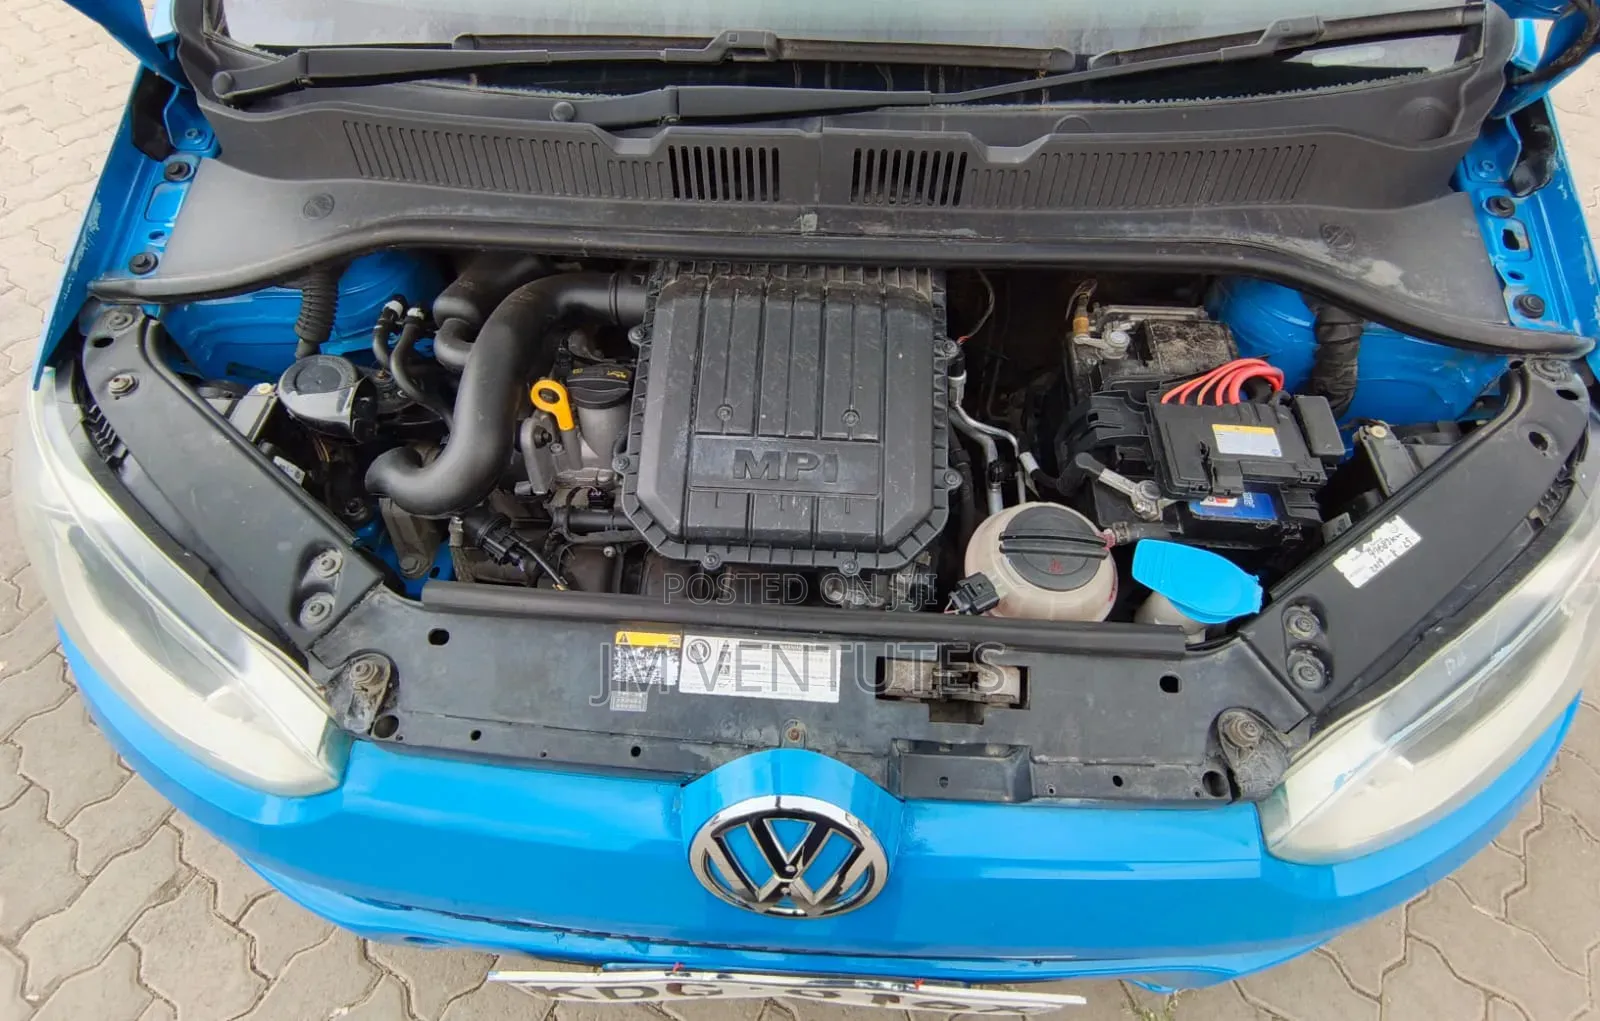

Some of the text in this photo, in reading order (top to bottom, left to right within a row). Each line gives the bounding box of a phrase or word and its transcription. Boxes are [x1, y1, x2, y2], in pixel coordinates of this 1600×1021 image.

[733, 449, 839, 484] MPI
[694, 804, 882, 913] VW
[530, 981, 724, 1000] KDG
